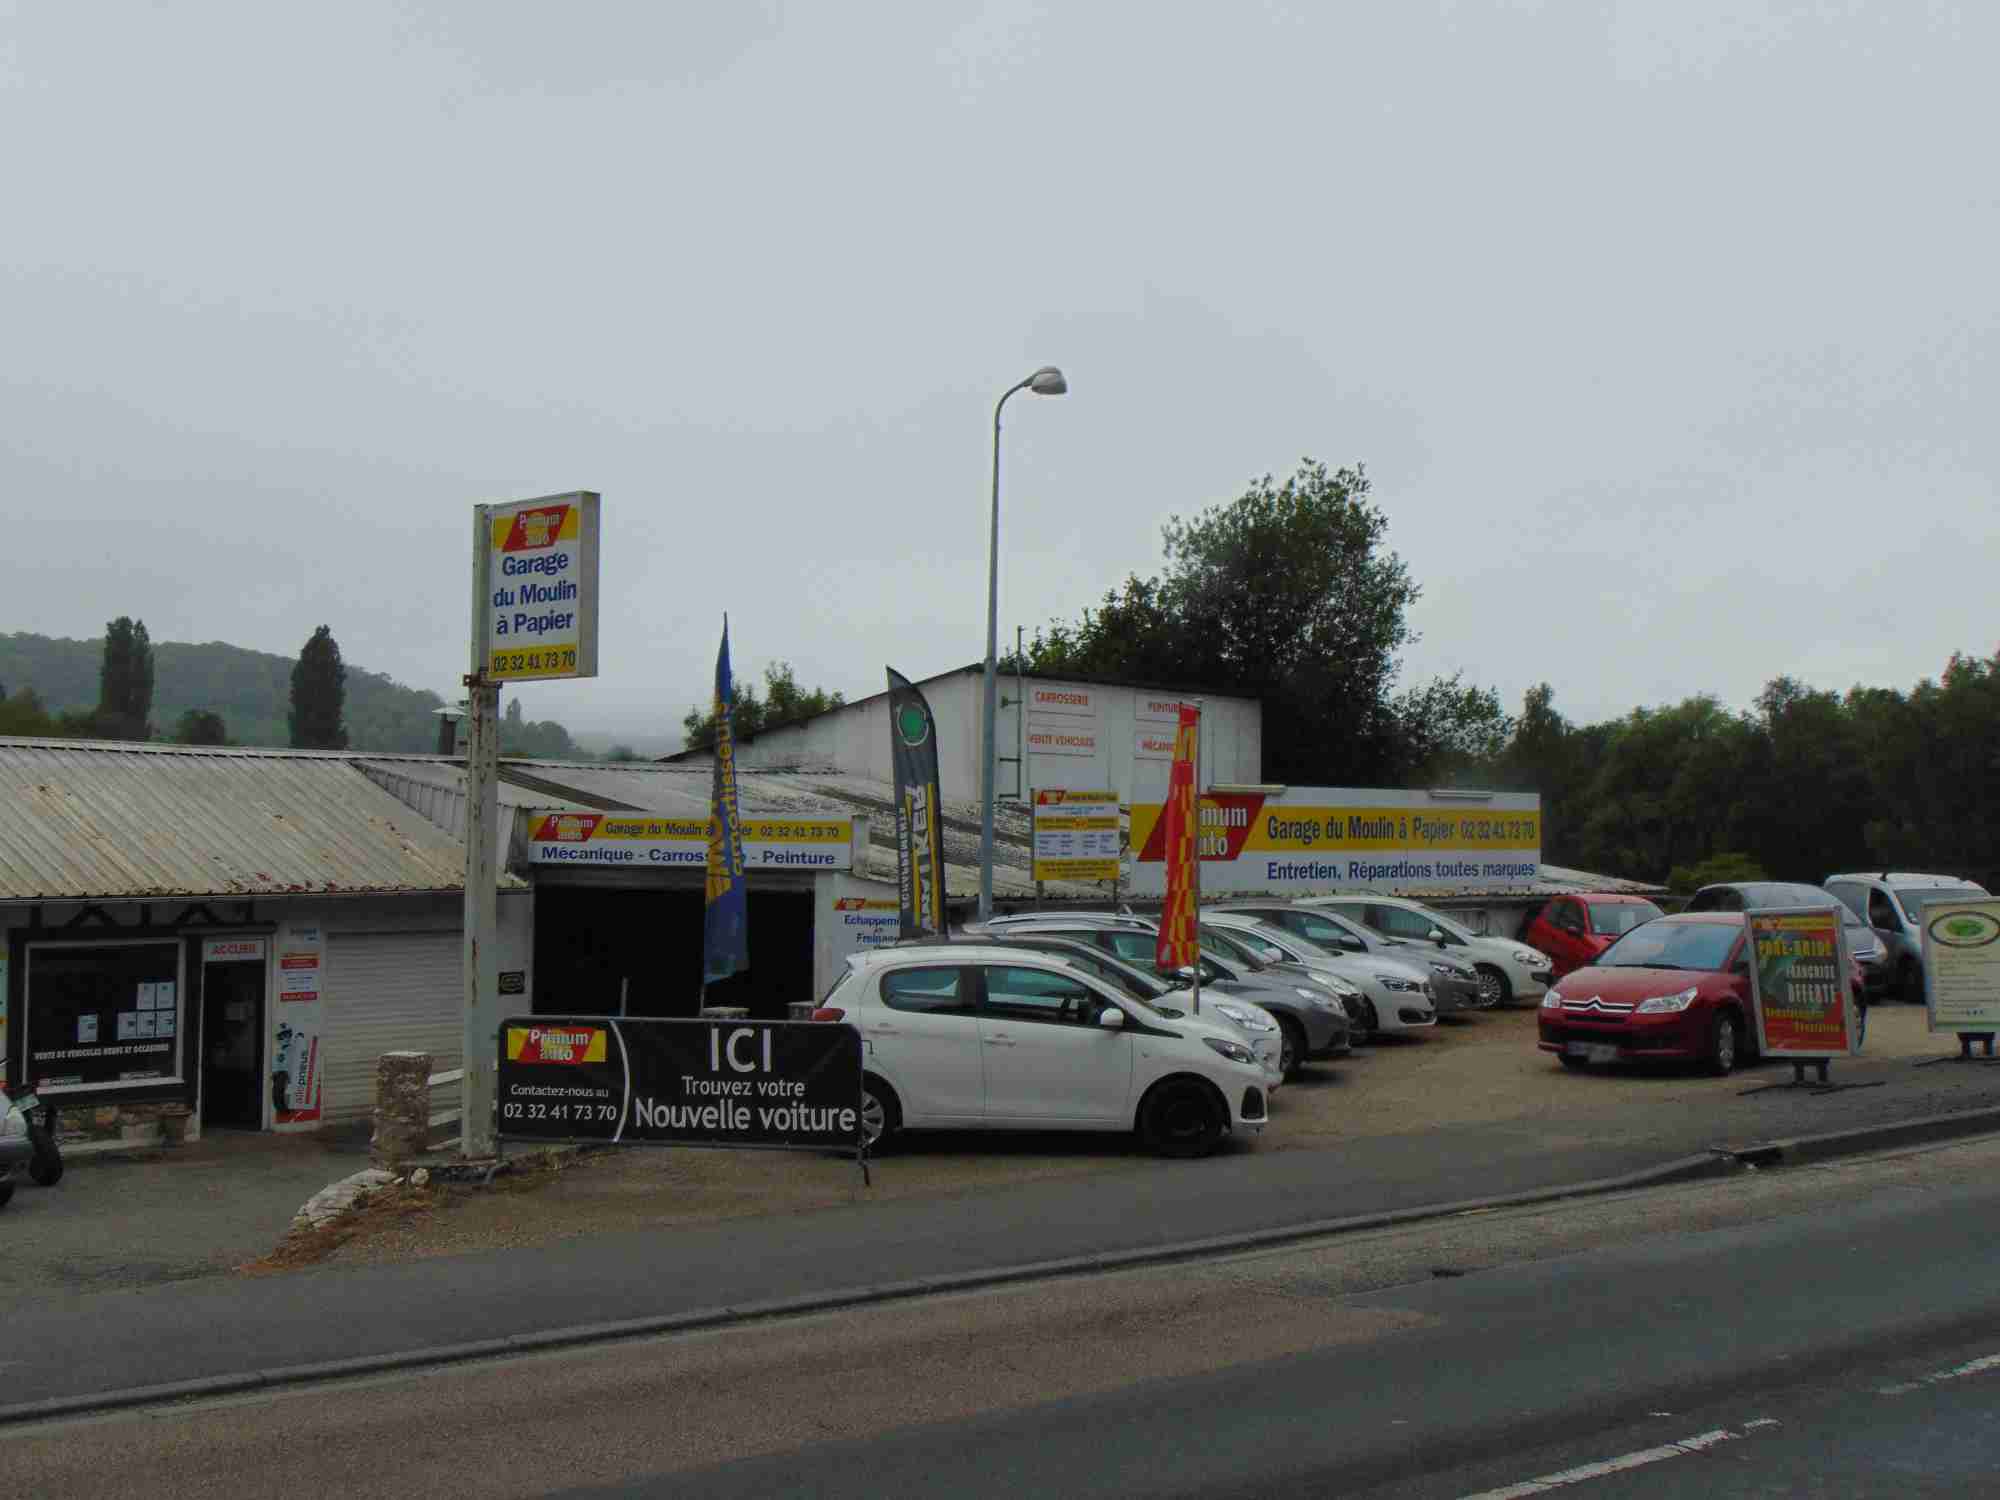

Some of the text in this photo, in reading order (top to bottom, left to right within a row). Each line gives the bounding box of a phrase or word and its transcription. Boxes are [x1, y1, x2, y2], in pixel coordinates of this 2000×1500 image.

[502, 552, 569, 576] Garage
[493, 580, 577, 608] du Moulin
[496, 610, 574, 635] à Papier
[494, 651, 576, 672] 02 32 41 73 70
[1200, 807, 1248, 828] mum
[1267, 815, 1321, 845] Garage
[1326, 815, 1344, 840] du
[1348, 815, 1394, 841] Moulin
[1399, 816, 1407, 840] à
[1413, 816, 1455, 845] Papier
[1200, 831, 1229, 856] uto
[541, 846, 634, 863] Mécanique
[762, 850, 835, 865] Peinture
[1348, 860, 1432, 882] Réparations
[1436, 861, 1479, 878] toutes
[1482, 862, 1536, 881] marques
[530, 1028, 590, 1047] Primum
[539, 1047, 574, 1061] auto
[710, 1027, 773, 1073] ICI
[510, 1083, 609, 1098] Contactez-nous au
[681, 1075, 806, 1097] Trouvez votre
[503, 1103, 617, 1121] 02 32 41 73 70
[634, 1096, 857, 1132] Nouvelle voiture
